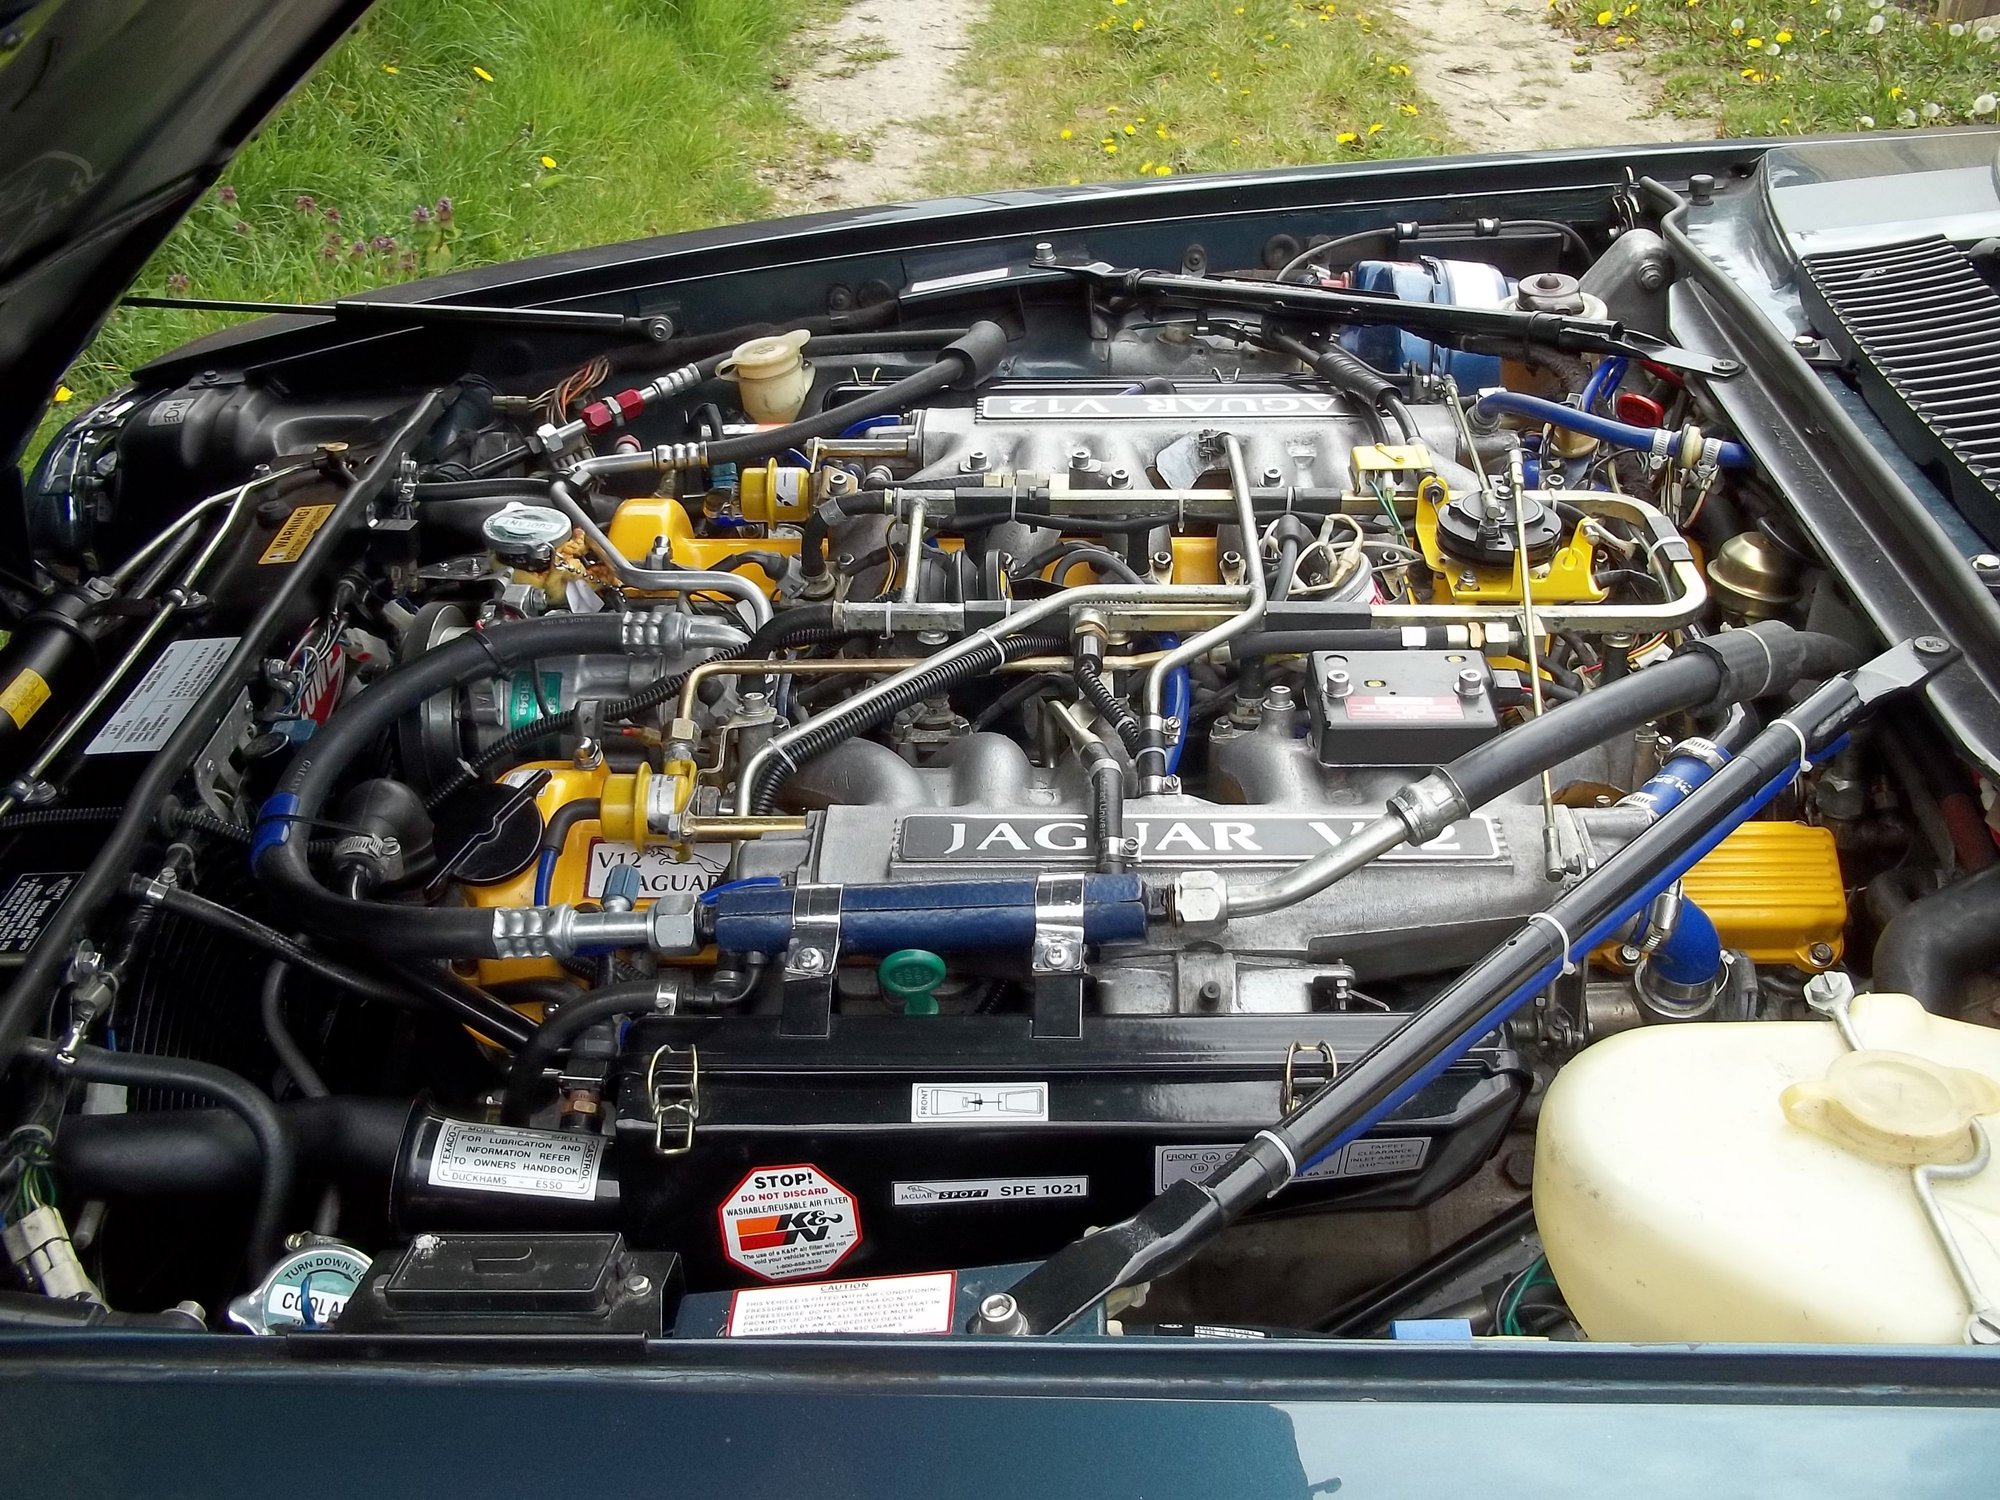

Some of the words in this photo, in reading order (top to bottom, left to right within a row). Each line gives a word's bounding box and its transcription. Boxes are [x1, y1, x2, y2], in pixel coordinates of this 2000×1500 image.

[1009, 400, 1110, 413] V12
[1147, 398, 1336, 412] AGUAR
[274, 509, 312, 549] WARNING!
[1308, 822, 1461, 850] V2
[640, 875, 719, 892] AGUAR
[921, 1089, 929, 1115] FRONT
[441, 1132, 457, 1164] TEXACO
[461, 1135, 481, 1143] FOR
[490, 1137, 553, 1149] LUBRICATION
[561, 1144, 581, 1152] AND
[466, 1146, 531, 1158] INFORMATION
[540, 1153, 570, 1162] REFER
[581, 1141, 596, 1180] CASTROL
[454, 1157, 466, 1165] TO
[474, 1158, 516, 1169] OWNERS
[523, 1163, 579, 1175] HANDBOOK
[452, 1172, 507, 1184] DUCKHAMS
[536, 1180, 563, 1190] ESSO
[755, 1173, 813, 1189] STOP!
[741, 1195, 755, 1203] DO
[759, 1192, 780, 1201] NOT
[784, 1187, 828, 1198] DISCARD
[901, 1190, 932, 1200] JAGUAR
[939, 1190, 988, 1200] SPORT
[1000, 1186, 1036, 1196] SPE
[1042, 1184, 1081, 1194] 1021
[726, 1203, 807, 1216] WASHABLE/REUSABLE
[809, 1200, 822, 1208] AIR
[824, 1197, 848, 1206] FILTER
[768, 1256, 782, 1264] your
[784, 1252, 810, 1261] vehicle's
[812, 1249, 838, 1259] warranty
[284, 1260, 313, 1280] TURN
[316, 1258, 351, 1270] DOWN
[820, 1282, 869, 1291] CAUTION
[766, 1298, 798, 1306] VEHICLE
[880, 1287, 942, 1296] CONDITIONING
[745, 1304, 800, 1313] PRESSURISED
[861, 1302, 906, 1310] EXCESSIVE
[742, 1326, 778, 1334] CARRIED
[826, 1317, 878, 1326] ACCREDITED
[743, 1318, 787, 1326] PROXIMITY
[853, 1310, 889, 1318] SERVICE
